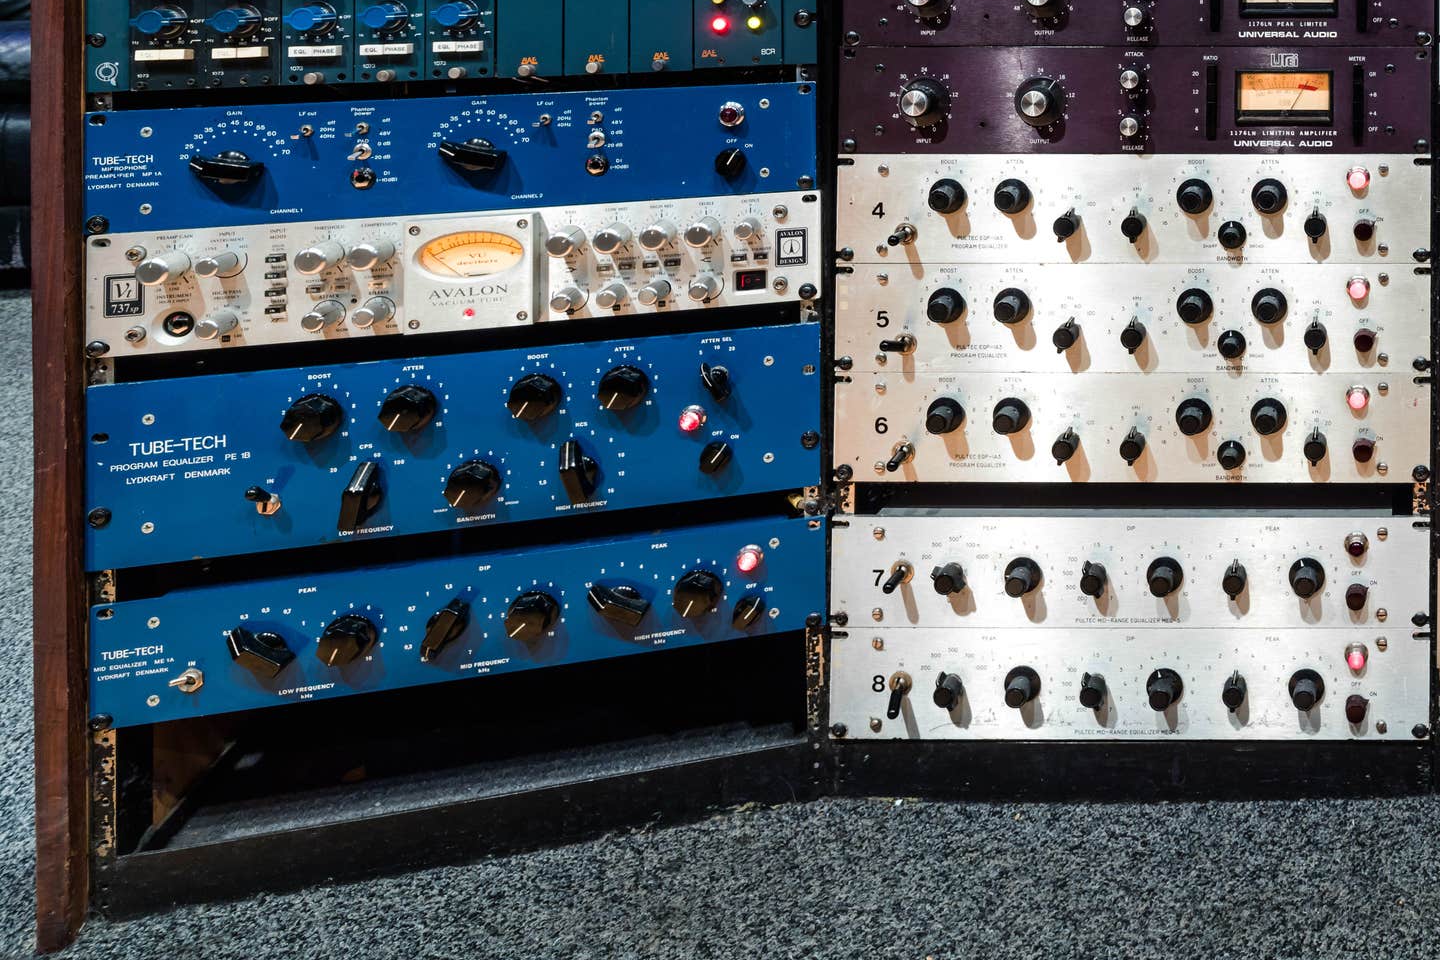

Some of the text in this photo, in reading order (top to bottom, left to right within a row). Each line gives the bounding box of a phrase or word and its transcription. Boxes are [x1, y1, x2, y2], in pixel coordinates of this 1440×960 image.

[92, 154, 153, 166] TUBE-TECH
[871, 202, 885, 219] 4
[778, 229, 804, 238] AVALON
[779, 257, 804, 266] DESIGN
[429, 284, 508, 300] AVALON
[876, 311, 889, 328] 5
[307, 372, 331, 380] BOOST
[875, 417, 888, 434] 6
[129, 434, 228, 457] TUBE-TECH
[110, 460, 158, 473] PROGRAM
[162, 455, 214, 467] EQUALIZER
[224, 452, 238, 461] PE
[126, 467, 231, 485] LYDKRAFT DENMARK
[555, 500, 608, 511] HIGH FREQUENCY
[456, 513, 496, 523] BANDWIDTH
[339, 525, 394, 537] LOW FREQUENCY
[872, 570, 885, 586] 7
[651, 629, 685, 639] FREQUENCY
[101, 644, 164, 661] TUBE-TECH
[93, 665, 107, 673] MID
[109, 661, 148, 671] EQUALIZER
[460, 658, 510, 670] MID FREQUENCY
[97, 666, 169, 682] LYDKRAFT DENMARK
[279, 683, 335, 696] LOW FREQUENCY
[871, 675, 885, 692] 8
